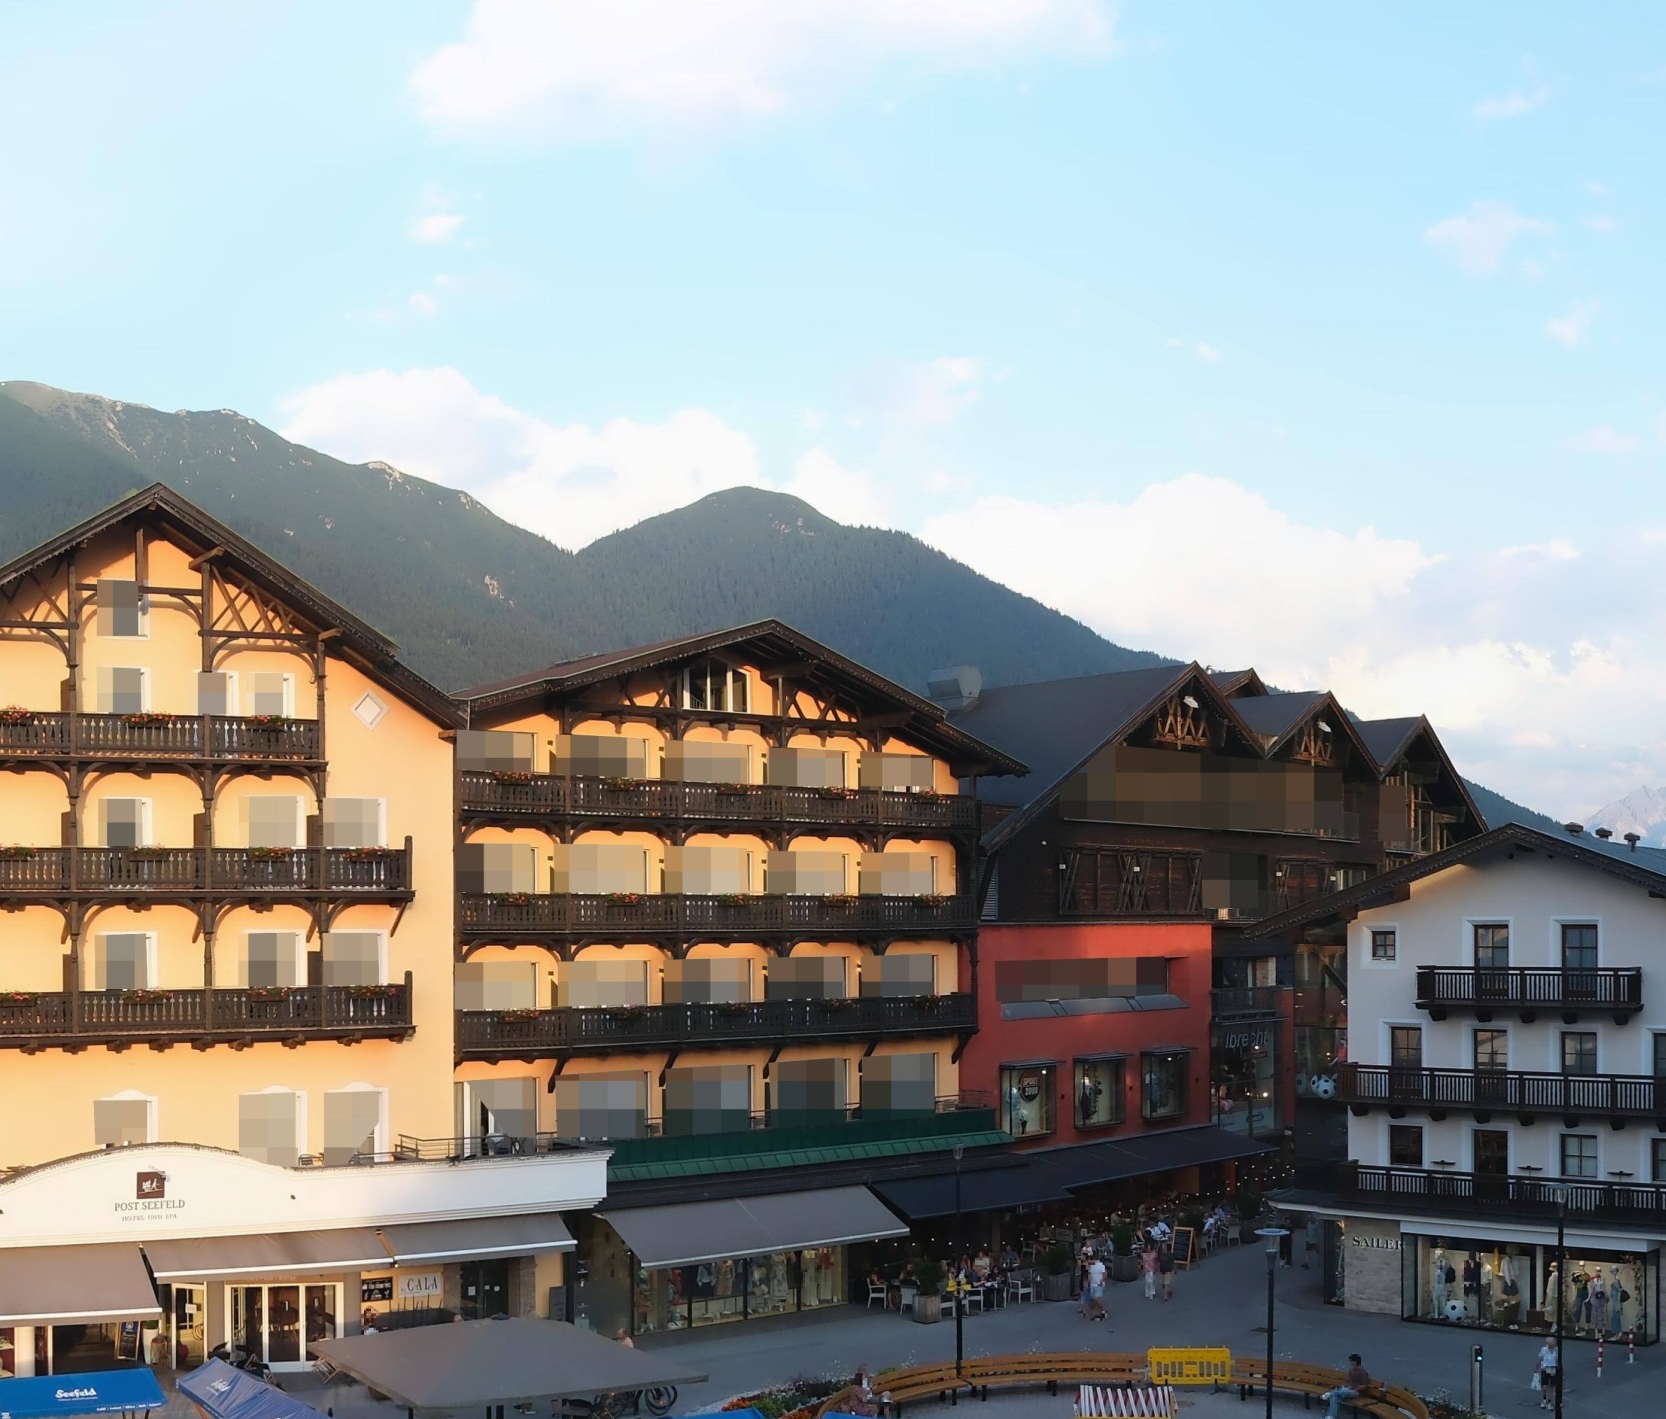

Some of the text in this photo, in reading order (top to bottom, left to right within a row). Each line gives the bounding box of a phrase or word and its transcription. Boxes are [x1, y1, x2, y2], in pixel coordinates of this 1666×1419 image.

[115, 1200, 185, 1211] POST SEEFELD
[55, 1387, 97, 1400] Seefeld
